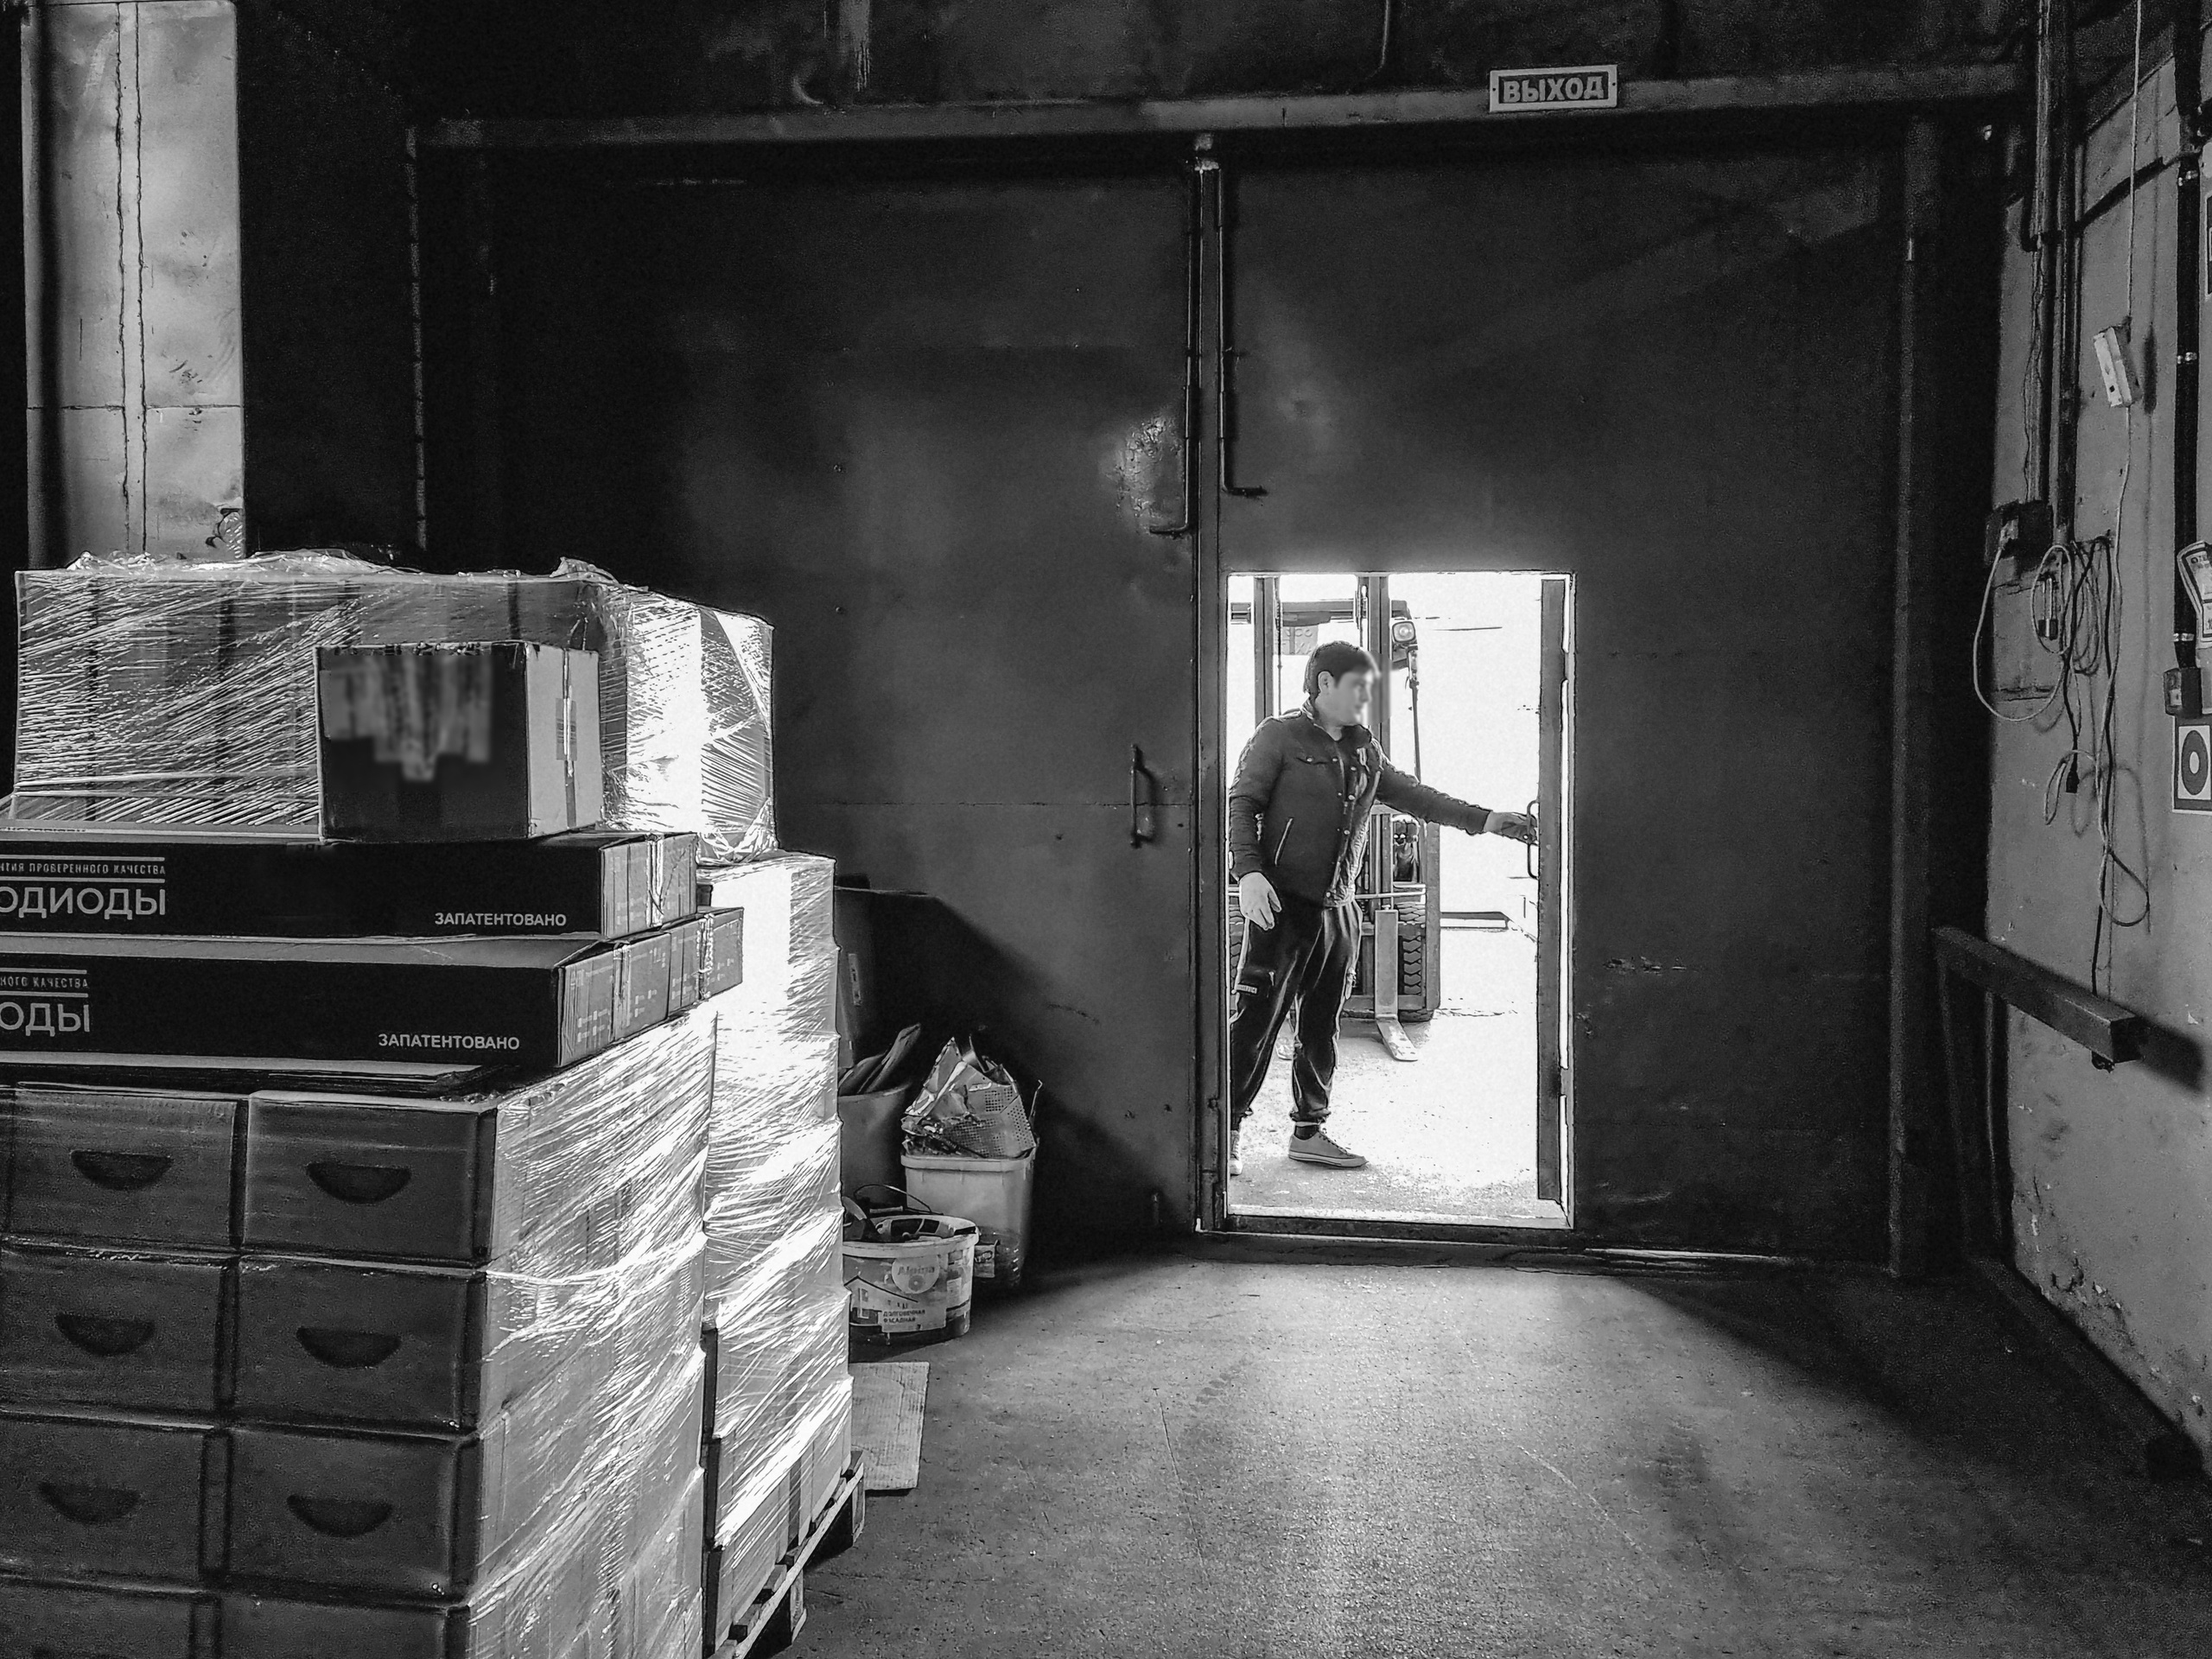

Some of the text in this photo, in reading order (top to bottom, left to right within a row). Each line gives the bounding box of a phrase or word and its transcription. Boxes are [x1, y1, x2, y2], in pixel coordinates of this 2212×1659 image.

[1503, 76, 1605, 102] ВЫХОД
[29, 862, 109, 874] ПРОВЕРЕННОГО
[113, 864, 166, 875] КАЧЕСТВА
[0, 886, 166, 920] ОДИОДЫ
[435, 912, 568, 927] ЗАПАТЕНТОВАНО
[33, 976, 89, 989] КАЧЕСТВА
[0, 1001, 90, 1037] ОДЫ
[378, 1033, 520, 1051] ЗАПАТЕНТОВАНО
